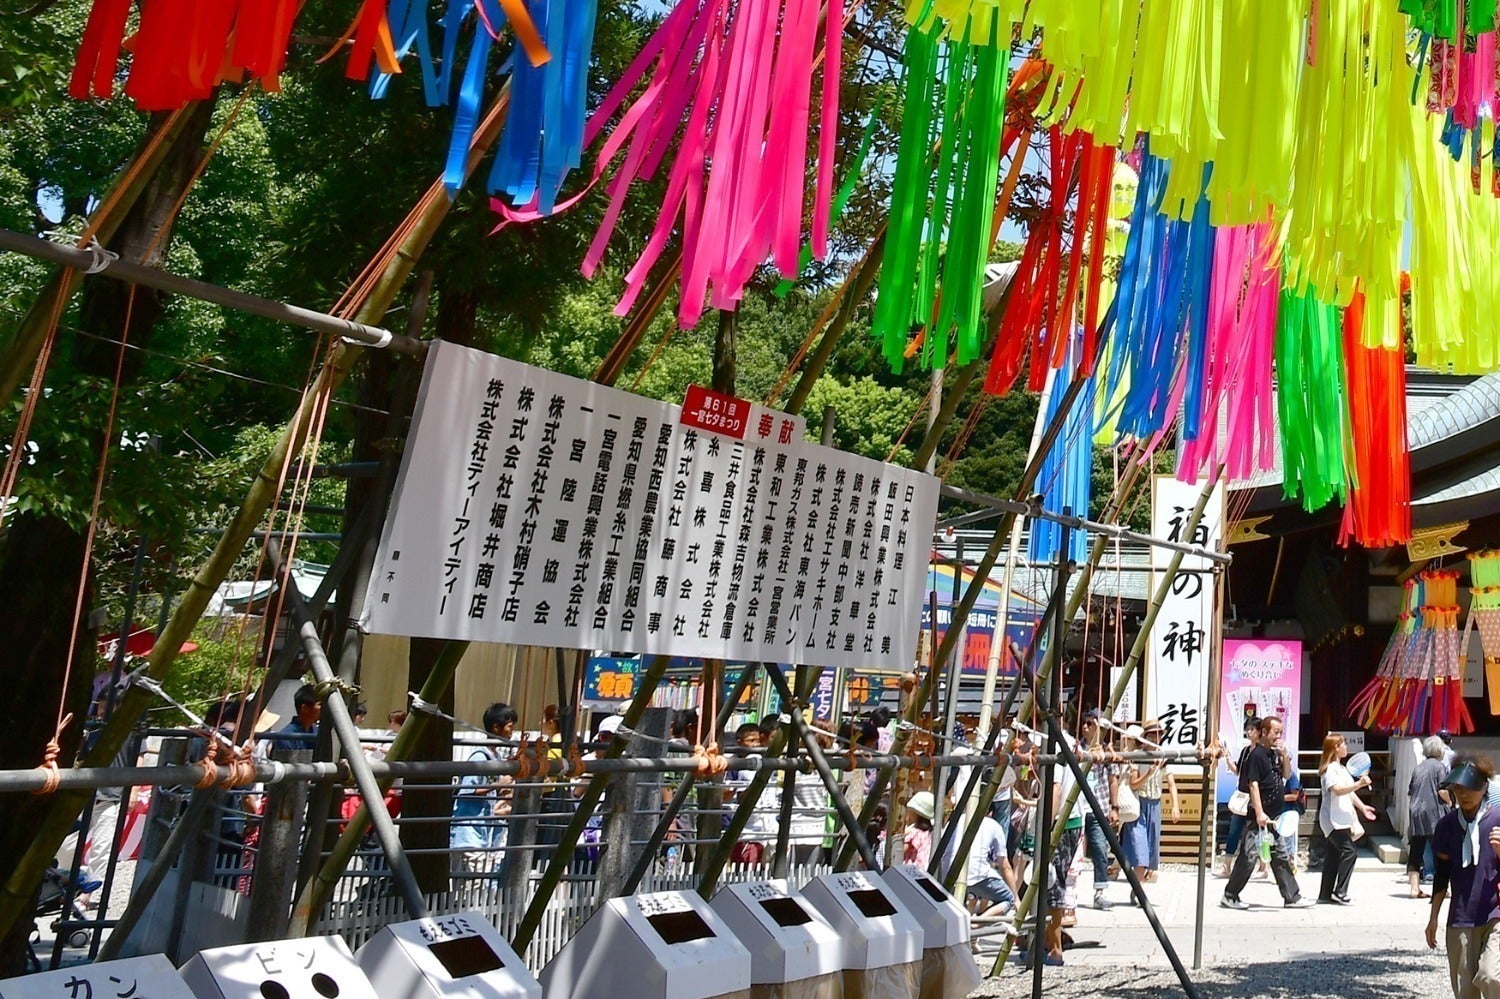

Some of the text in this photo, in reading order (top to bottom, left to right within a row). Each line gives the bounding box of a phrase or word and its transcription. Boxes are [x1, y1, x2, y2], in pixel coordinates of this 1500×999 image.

[439, 377, 505, 616] 株式会社ディーアイディー
[468, 386, 535, 620] 株式会社堀井商店
[690, 410, 740, 431] 一宮七夕まつり
[703, 396, 737, 416] 第61回
[758, 413, 795, 445] 奉献
[500, 394, 565, 623] 株式会社木村硝子店
[533, 405, 594, 625] 一宮陸運協会
[563, 413, 621, 627] 一宮電話興業株式会社
[592, 416, 647, 631] 愛知県撚糸工業組合
[620, 423, 673, 633] 愛知西農業協同組合
[647, 428, 697, 634] 株式会社藤商事
[673, 436, 719, 636] 糸喜株式会社
[698, 441, 744, 638] 三井食品工業株式会社
[719, 446, 765, 640] 株式会社森吉物流倉庫
[742, 452, 787, 643] 東和工業株式会社
[763, 458, 808, 645] 東邦ガス株式会社一宮営業所
[805, 467, 846, 648] 株式会社エサキホーム
[64, 975, 137, 999] カン
[255, 947, 316, 974] ビン
